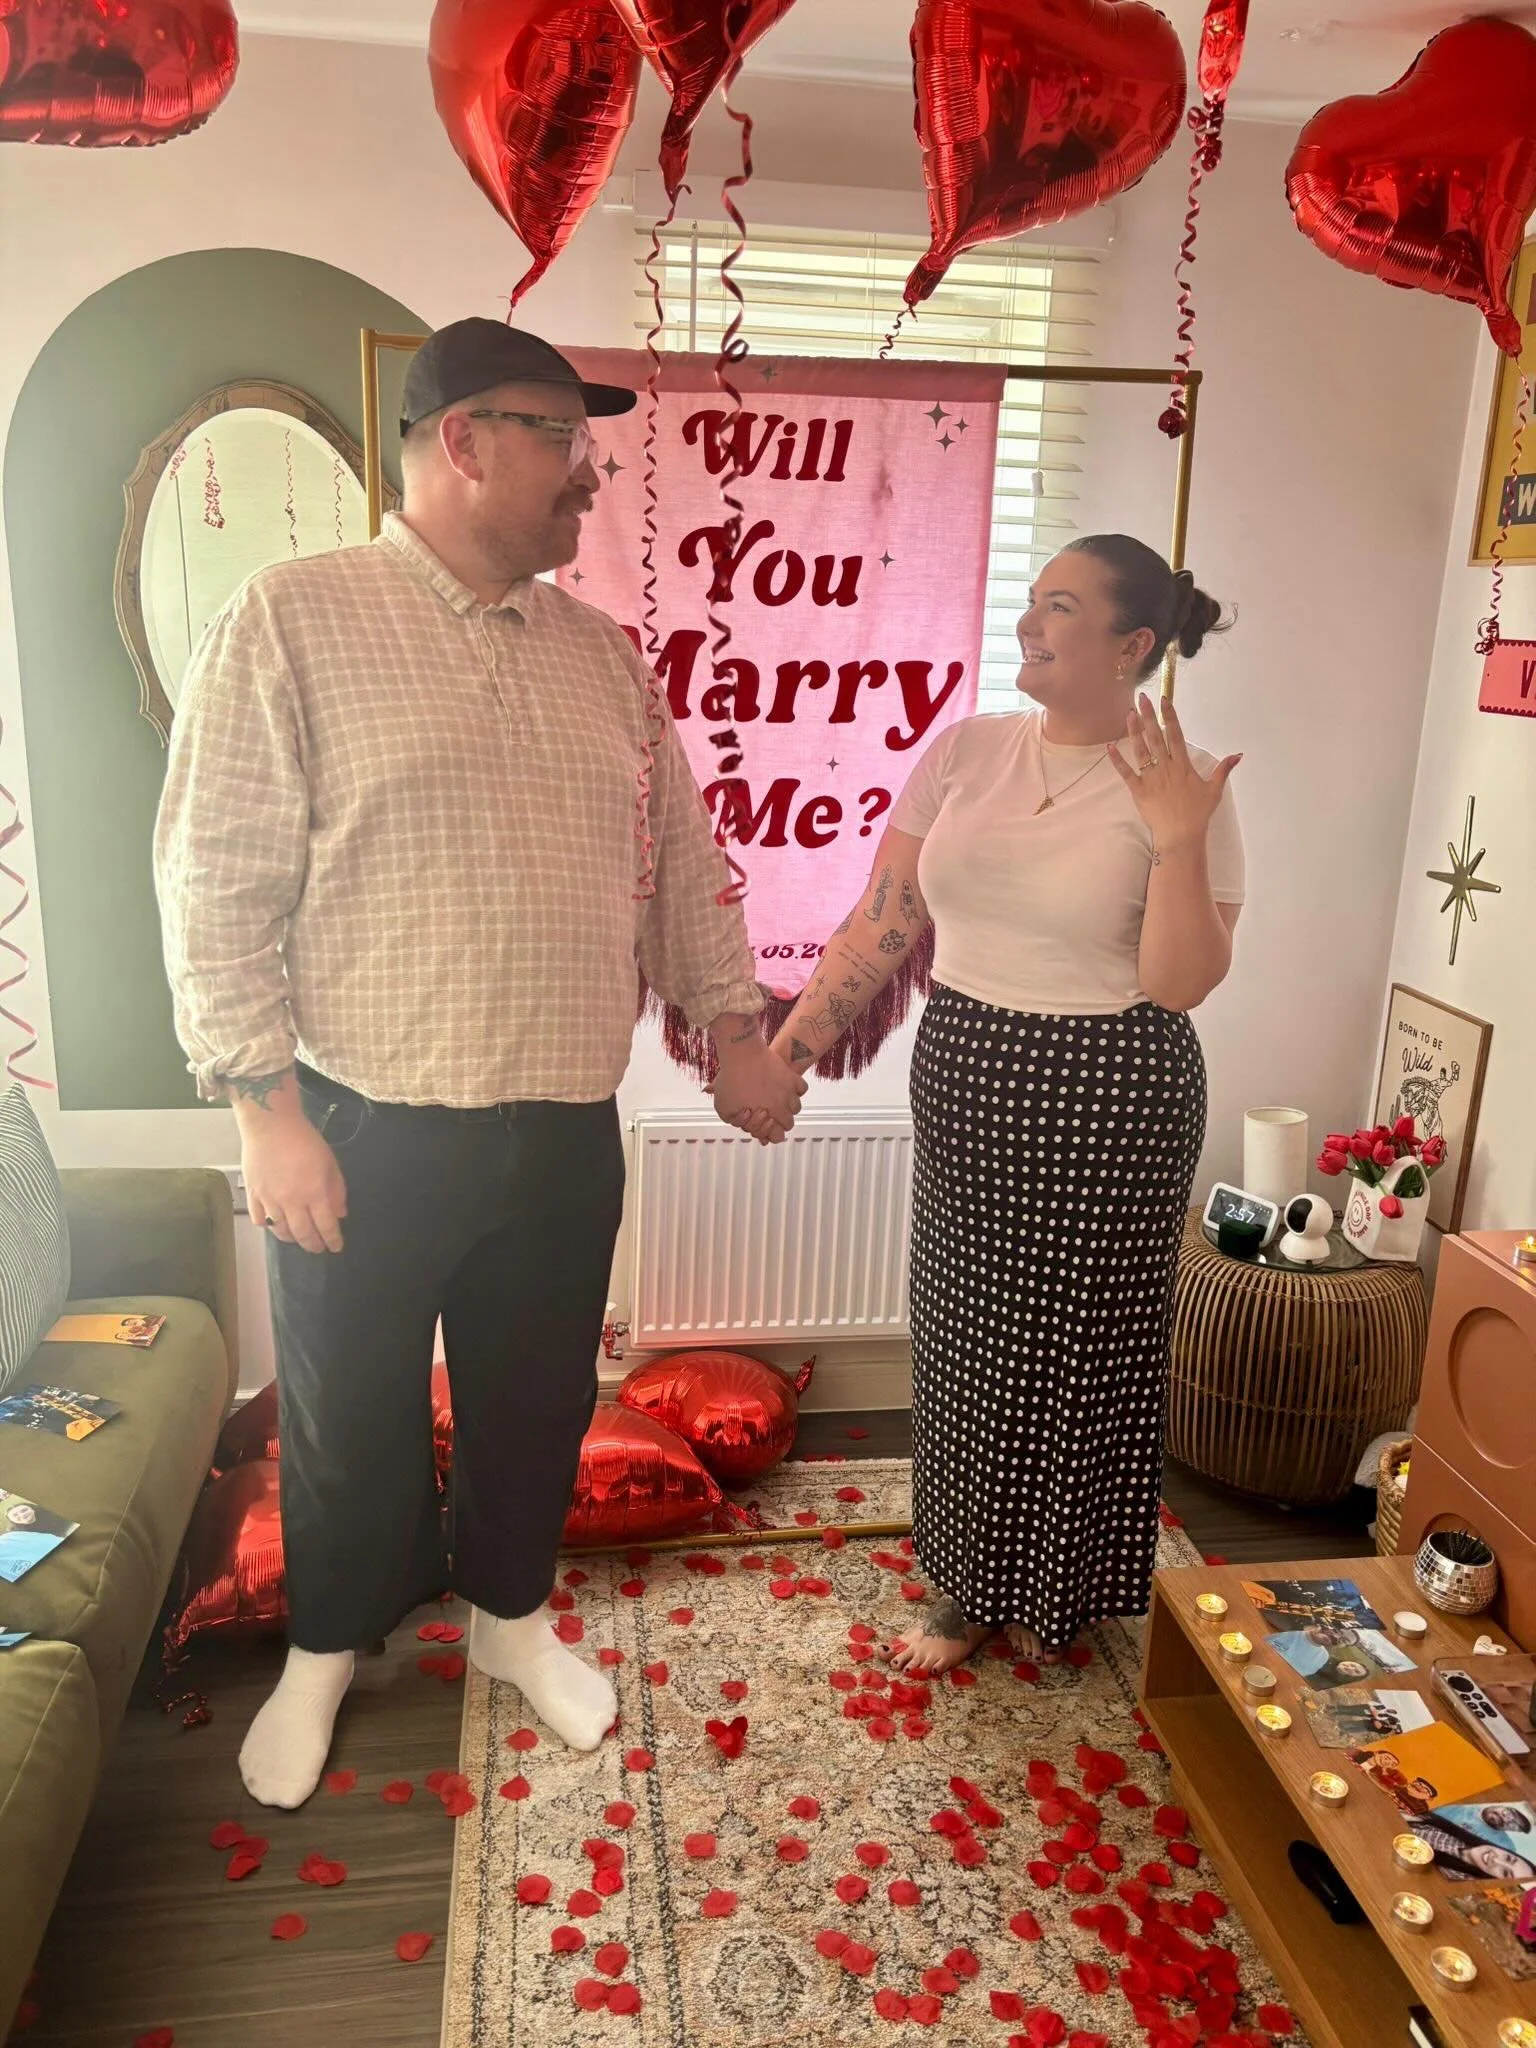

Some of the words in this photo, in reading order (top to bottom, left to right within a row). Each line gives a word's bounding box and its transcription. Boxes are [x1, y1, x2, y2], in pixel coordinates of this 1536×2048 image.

[682, 410, 854, 482] Will
[678, 519, 863, 608] You
[618, 624, 964, 751] Marry
[701, 777, 892, 849] Me?
[1398, 1021, 1418, 1039] BORN
[1420, 1031, 1430, 1044] TO
[1432, 1037, 1443, 1051] BE
[1401, 1046, 1434, 1073] Wild
[1225, 1203, 1256, 1224] 2:57
